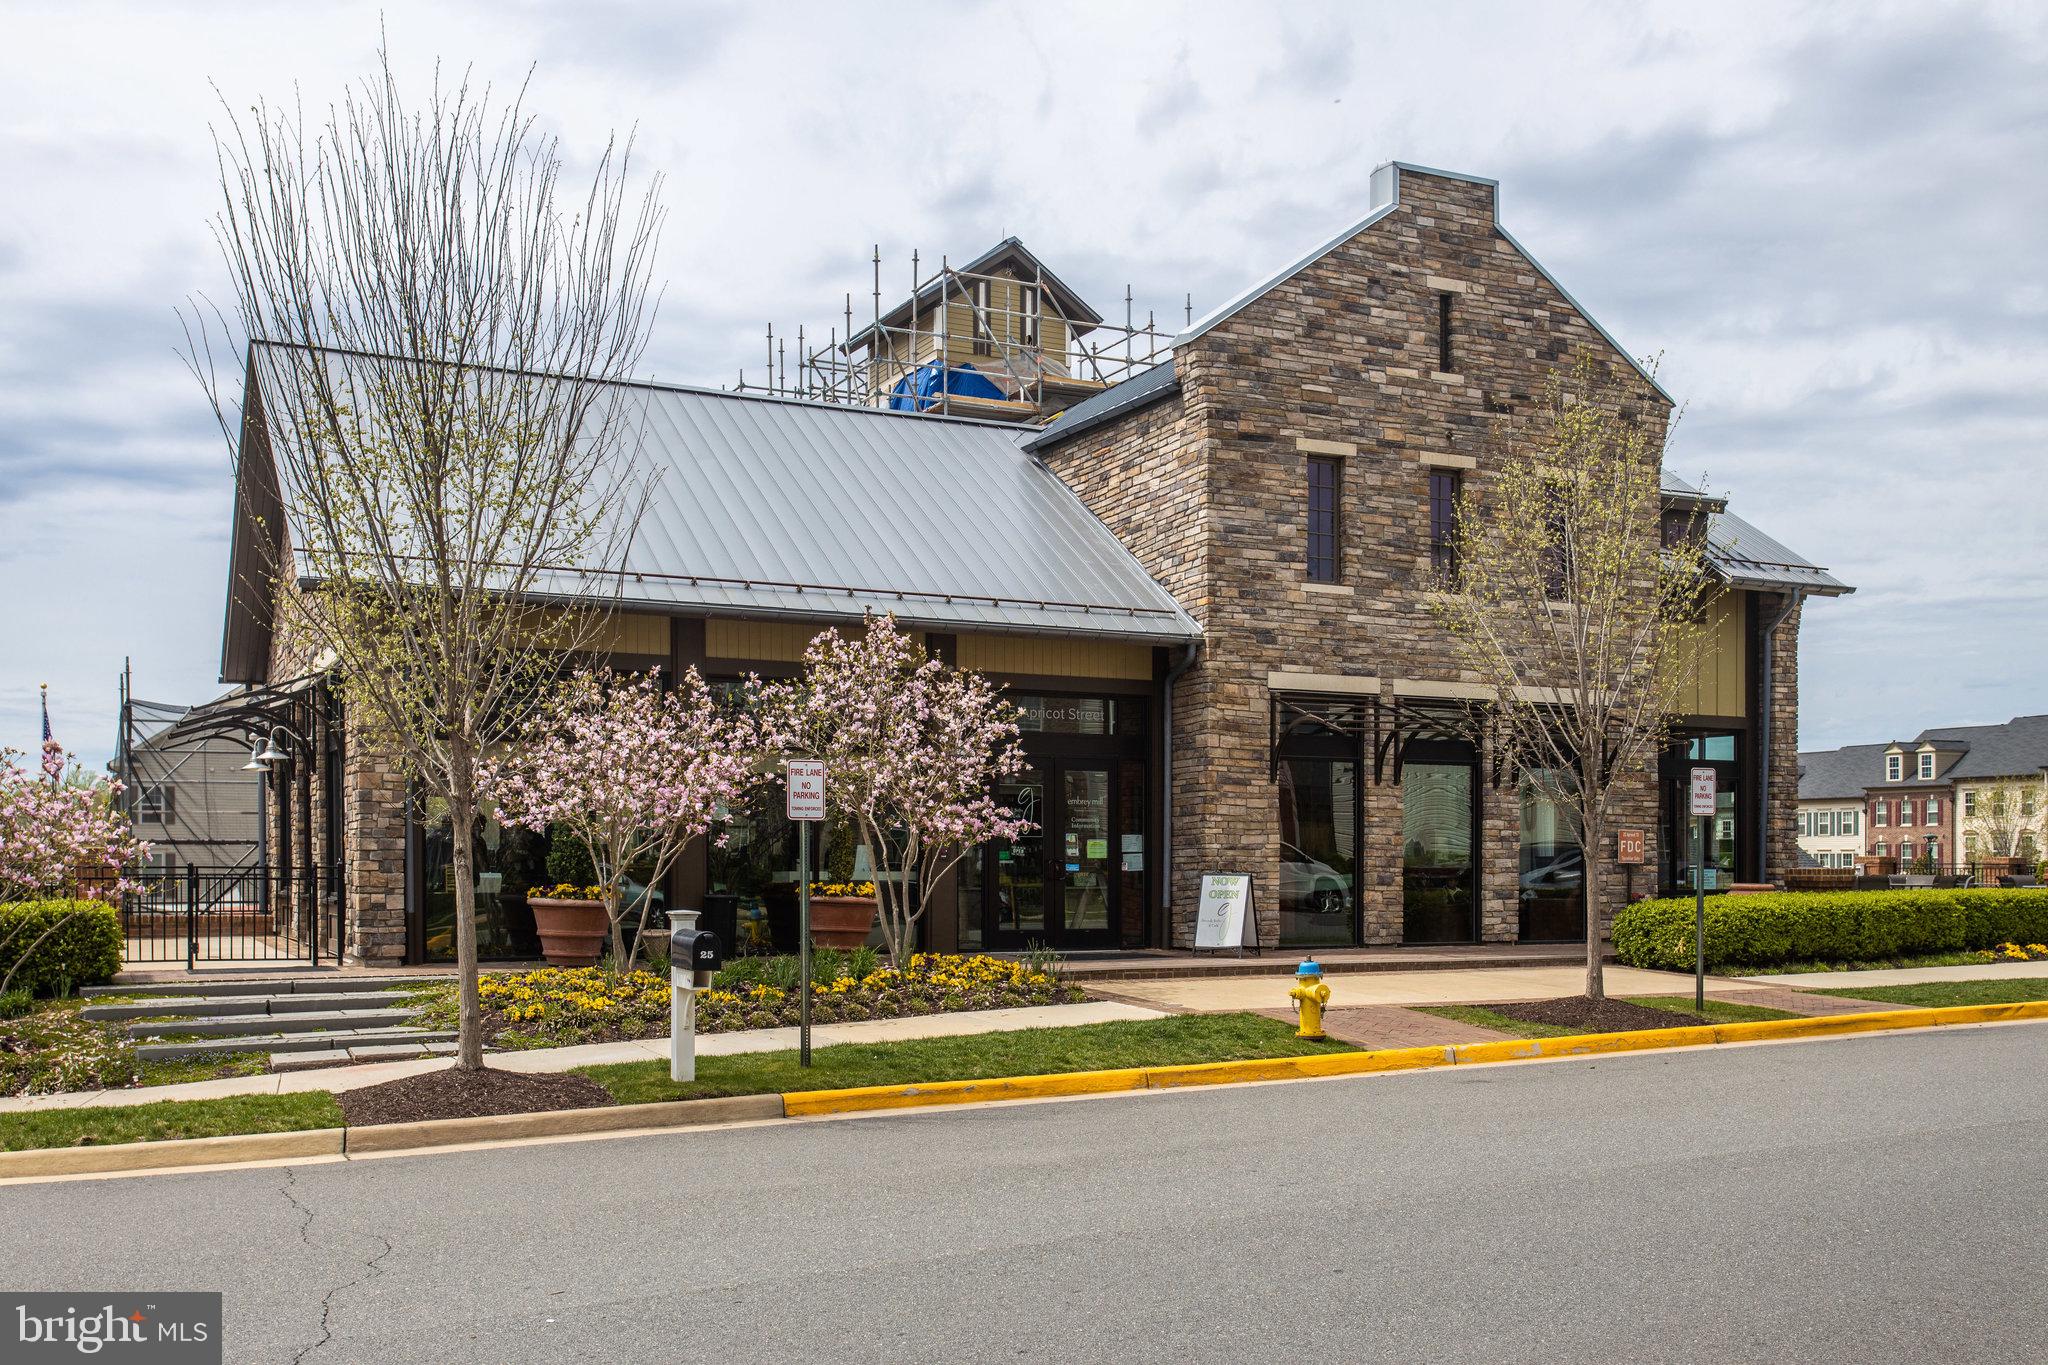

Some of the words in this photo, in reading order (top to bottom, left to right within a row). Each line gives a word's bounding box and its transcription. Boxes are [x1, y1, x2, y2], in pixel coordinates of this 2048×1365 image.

[1068, 708, 1105, 721] Street
[1620, 841, 1641, 852] FDC
[1211, 876, 1240, 886] NOW
[1208, 889, 1239, 899] OPEN
[699, 950, 714, 959] 25
